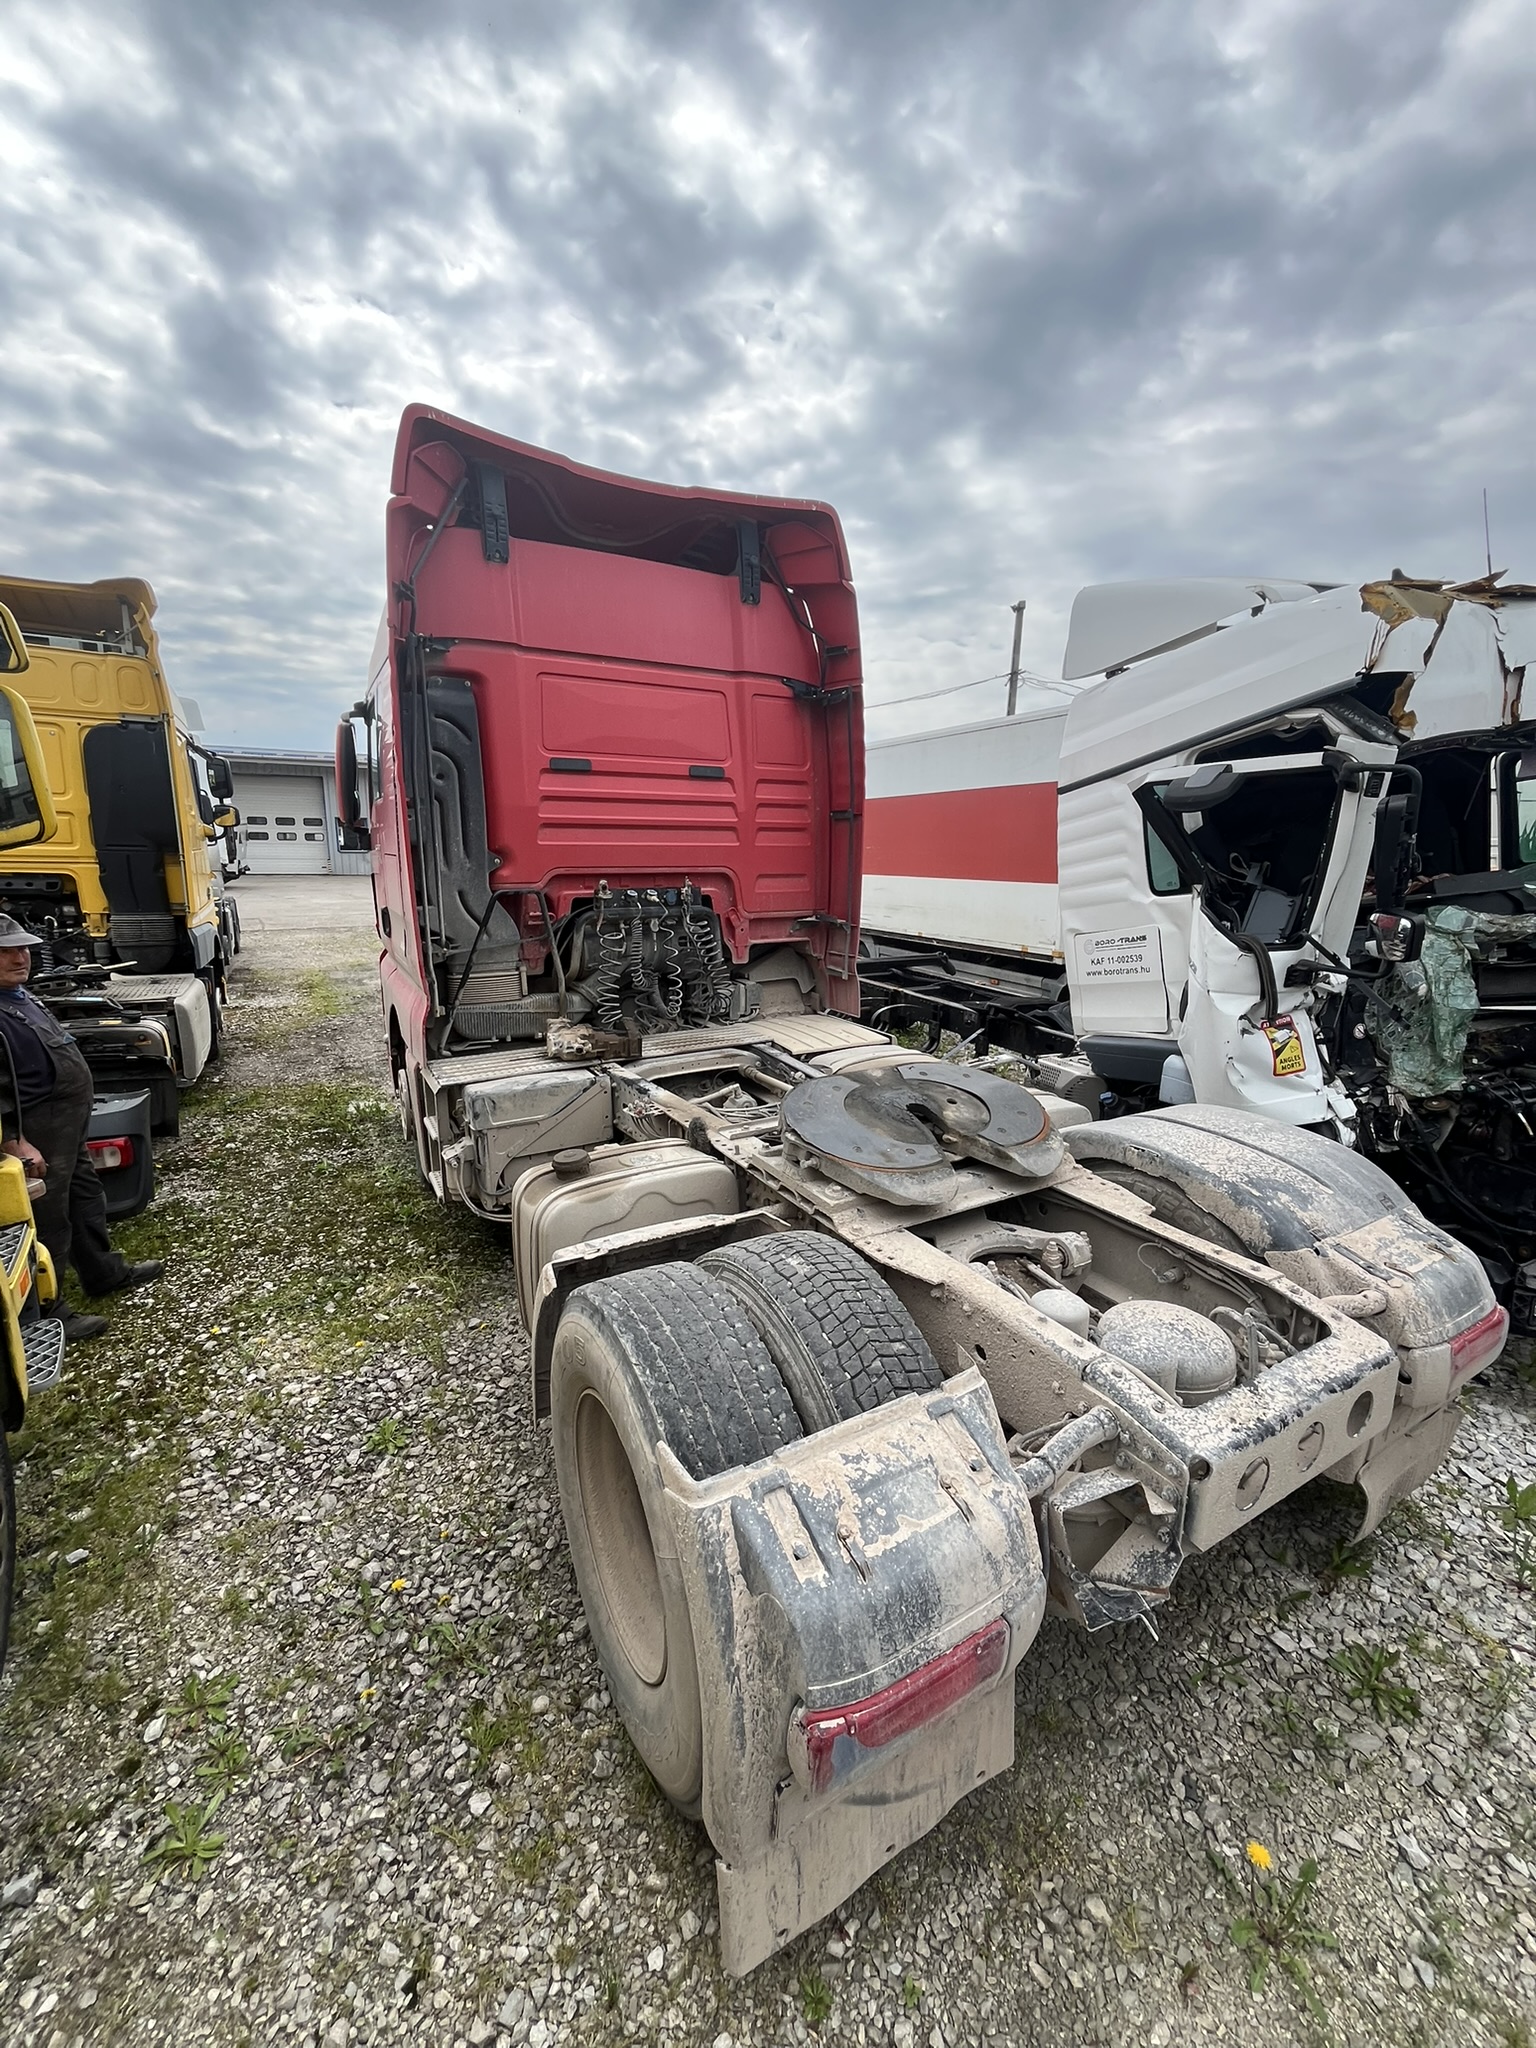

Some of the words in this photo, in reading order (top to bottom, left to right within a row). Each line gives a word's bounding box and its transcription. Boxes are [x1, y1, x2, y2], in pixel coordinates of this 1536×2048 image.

[1091, 957, 1105, 966] KAF
[1107, 954, 1143, 964] 11-002539
[1086, 966, 1151, 977] www.borotrans.hu
[1279, 1055, 1301, 1065] ANGLES
[1281, 1061, 1301, 1071] MORTS
